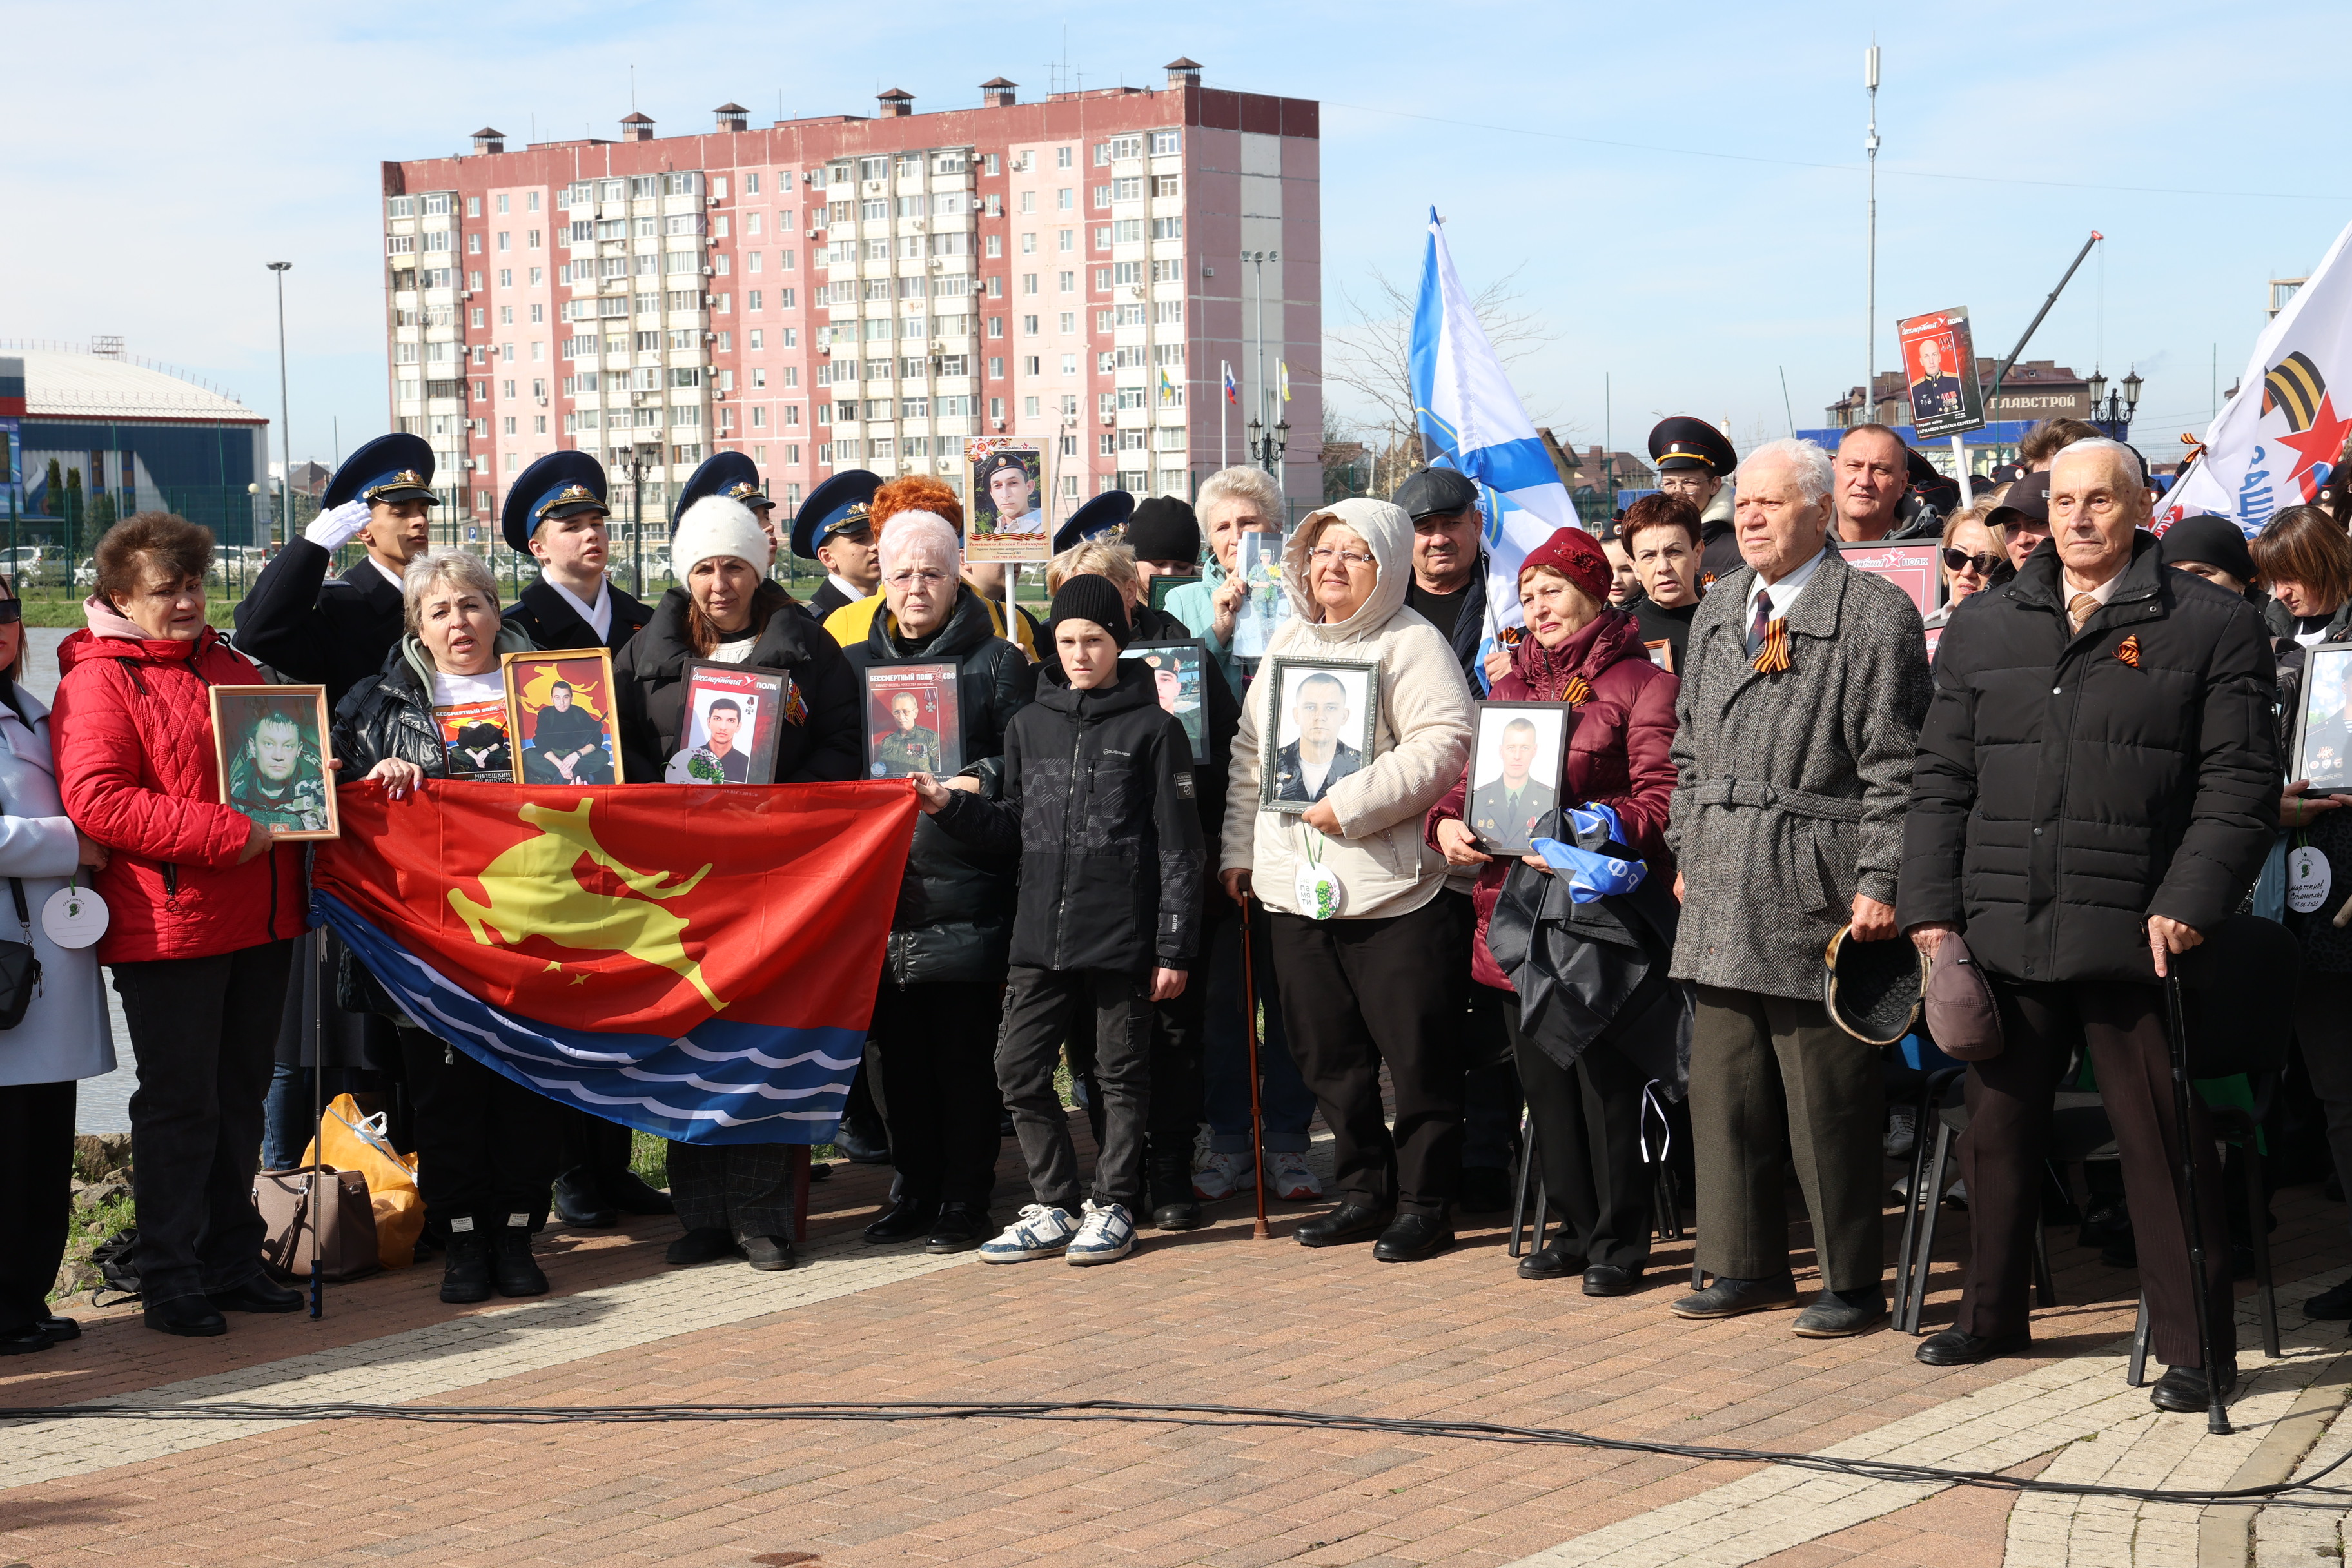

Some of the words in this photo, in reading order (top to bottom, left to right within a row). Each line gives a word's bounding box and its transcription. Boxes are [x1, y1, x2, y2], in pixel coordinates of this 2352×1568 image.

[1990, 395, 2075, 409] ГЛАВСТРОЙ
[869, 673, 915, 682] БЕССМЕРТНЫЙ
[916, 672, 933, 681] ПОЛК
[756, 681, 778, 691] ПОЛК
